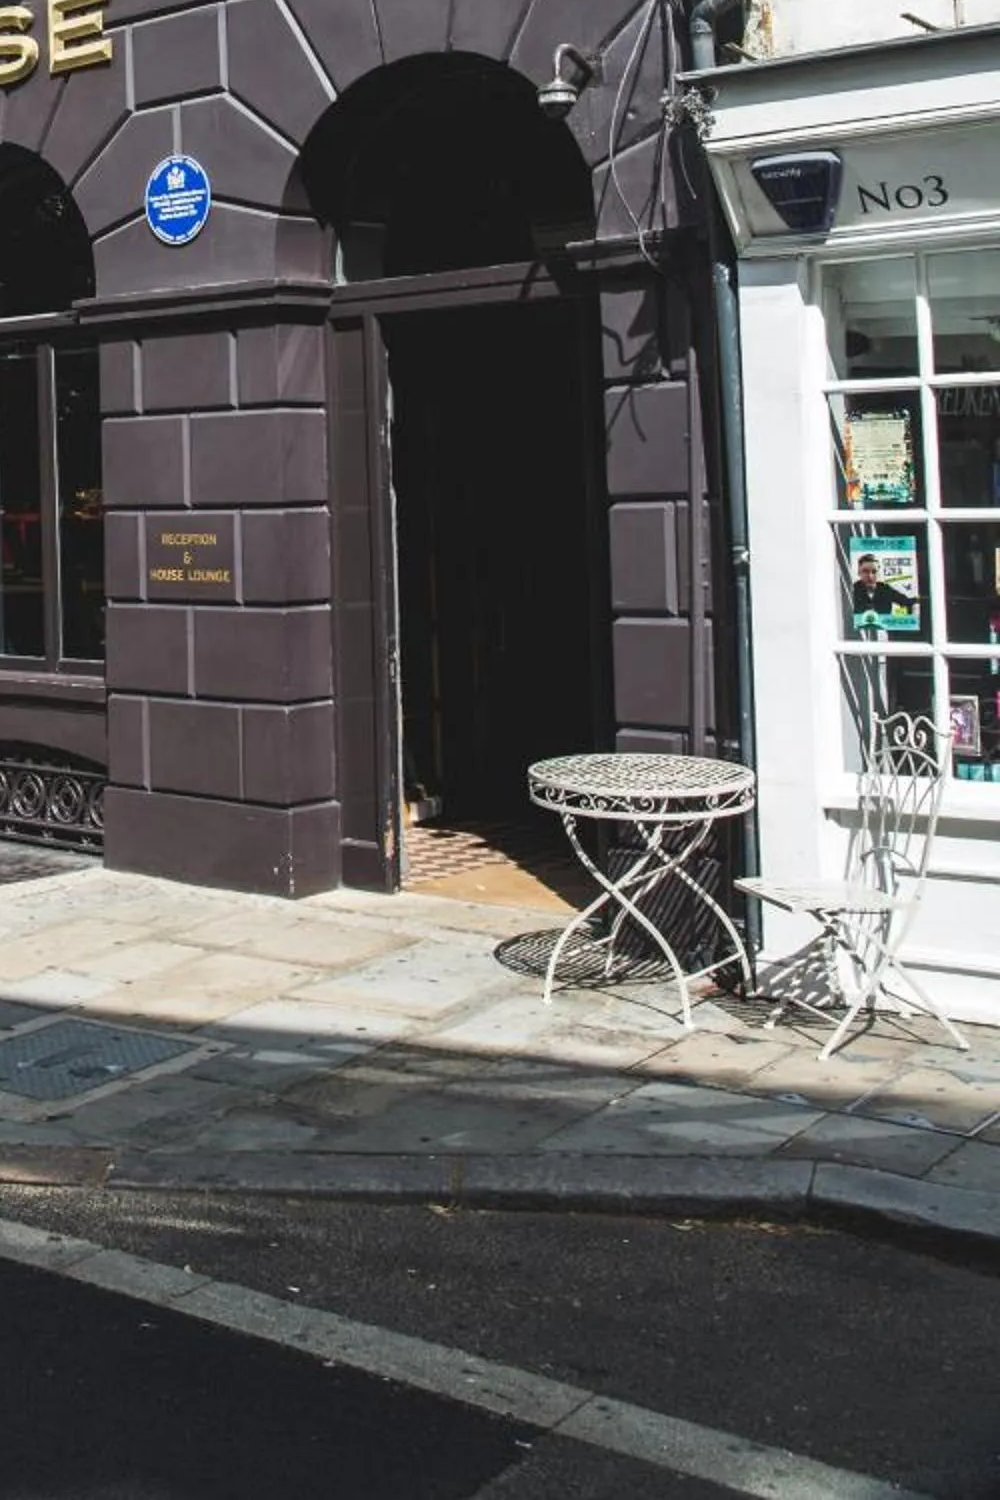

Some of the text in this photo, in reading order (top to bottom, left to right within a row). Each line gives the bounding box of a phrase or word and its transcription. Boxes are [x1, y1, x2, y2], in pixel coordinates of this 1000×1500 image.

[857, 175, 949, 214] No3
[151, 569, 230, 583] HOUSE LOUNGE
